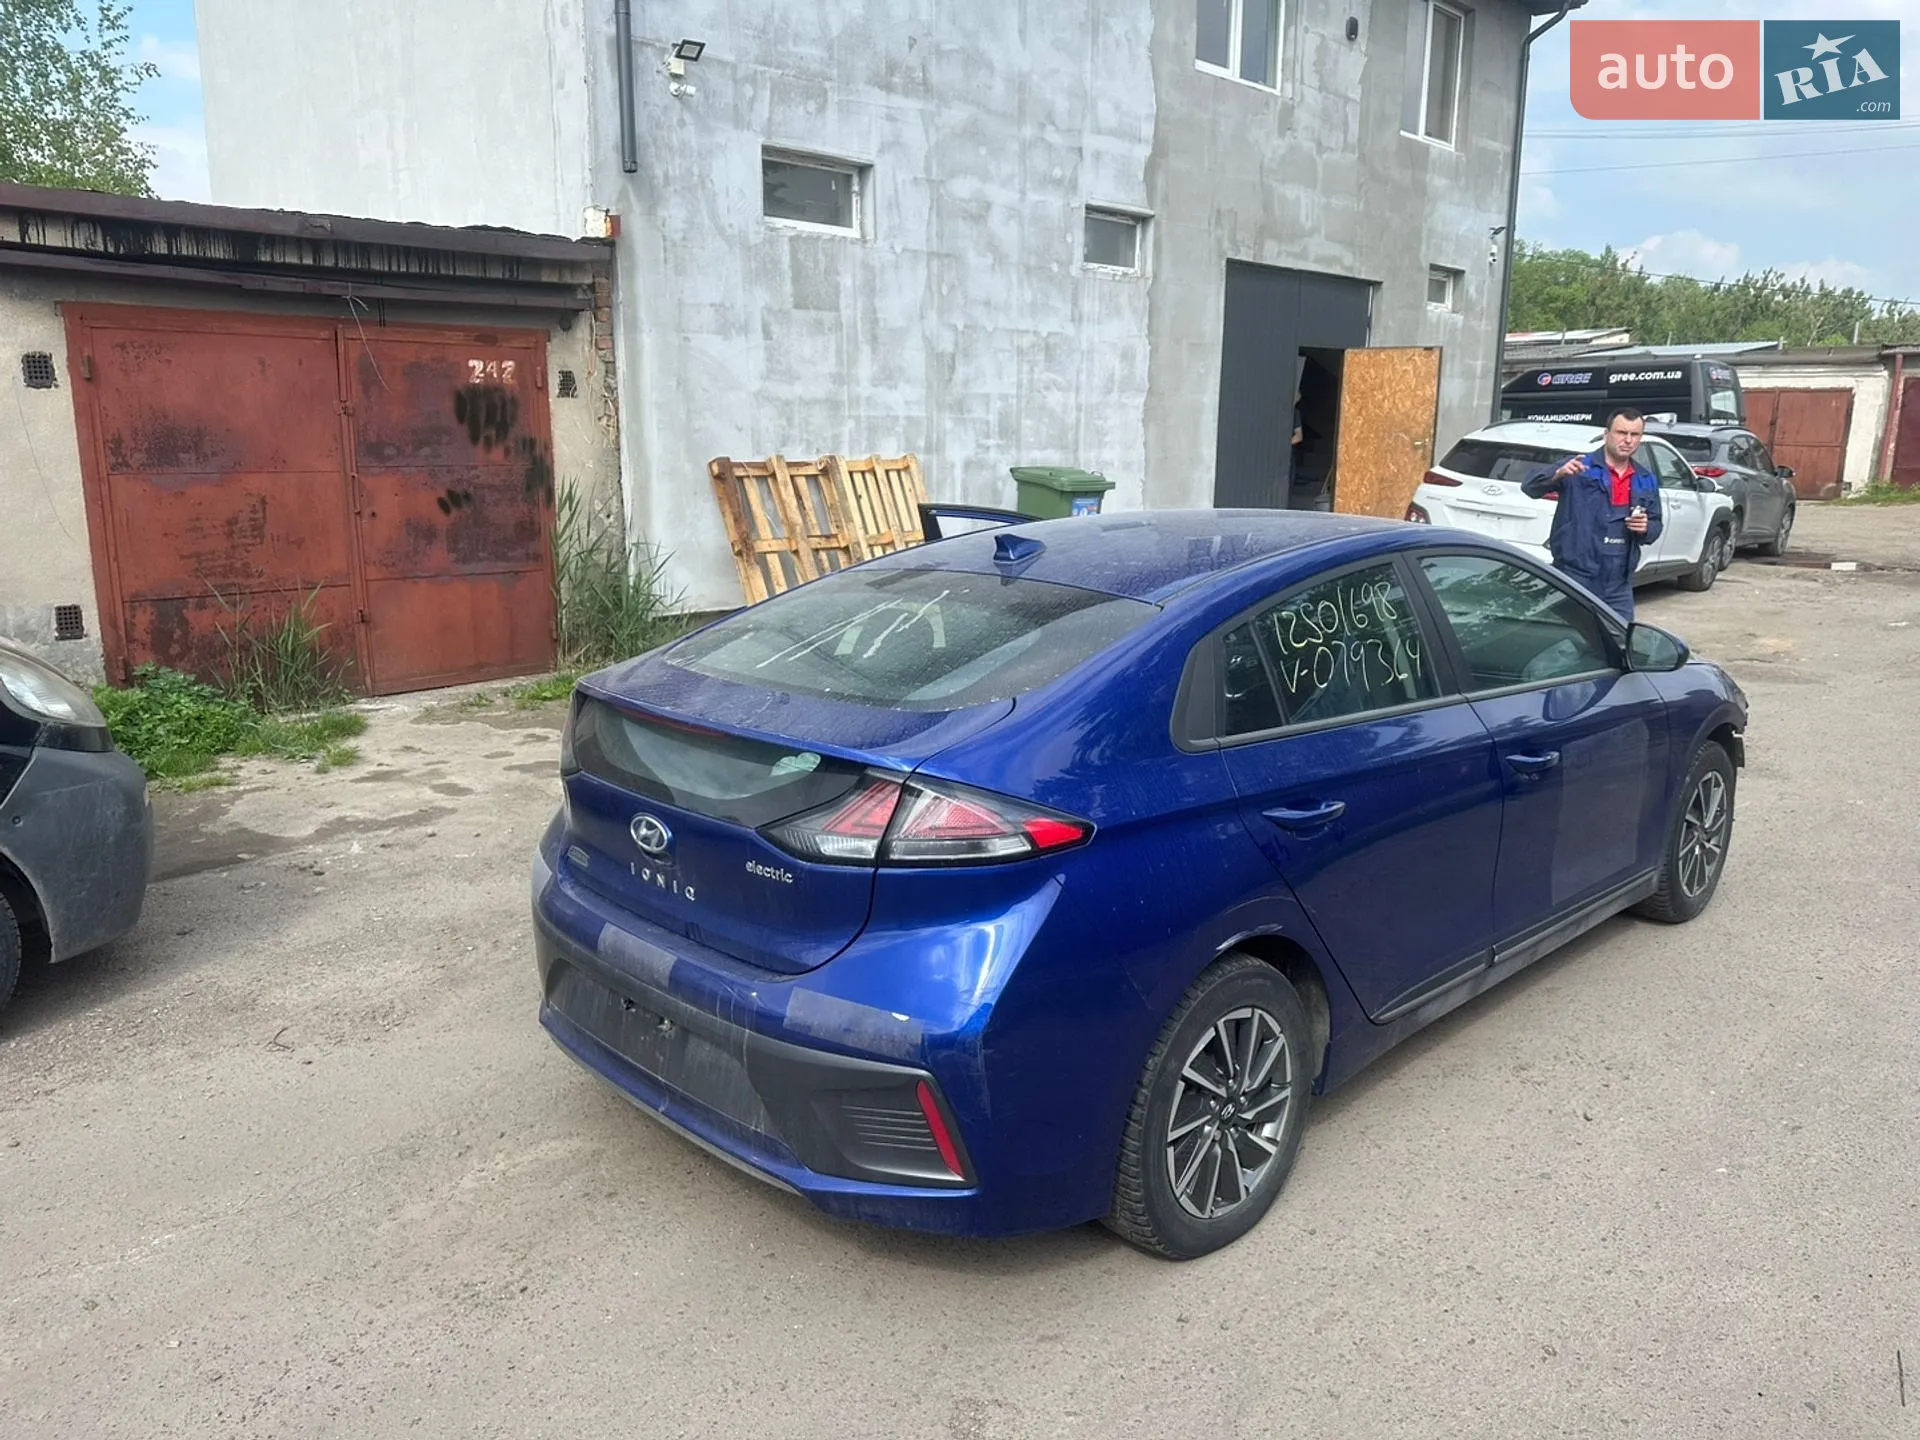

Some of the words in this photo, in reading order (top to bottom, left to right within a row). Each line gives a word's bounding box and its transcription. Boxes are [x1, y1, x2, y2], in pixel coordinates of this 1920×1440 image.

[1609, 370, 1682, 384] gree.com.ua
[630, 862, 696, 901] IONIQ
[745, 859, 794, 884] electric
